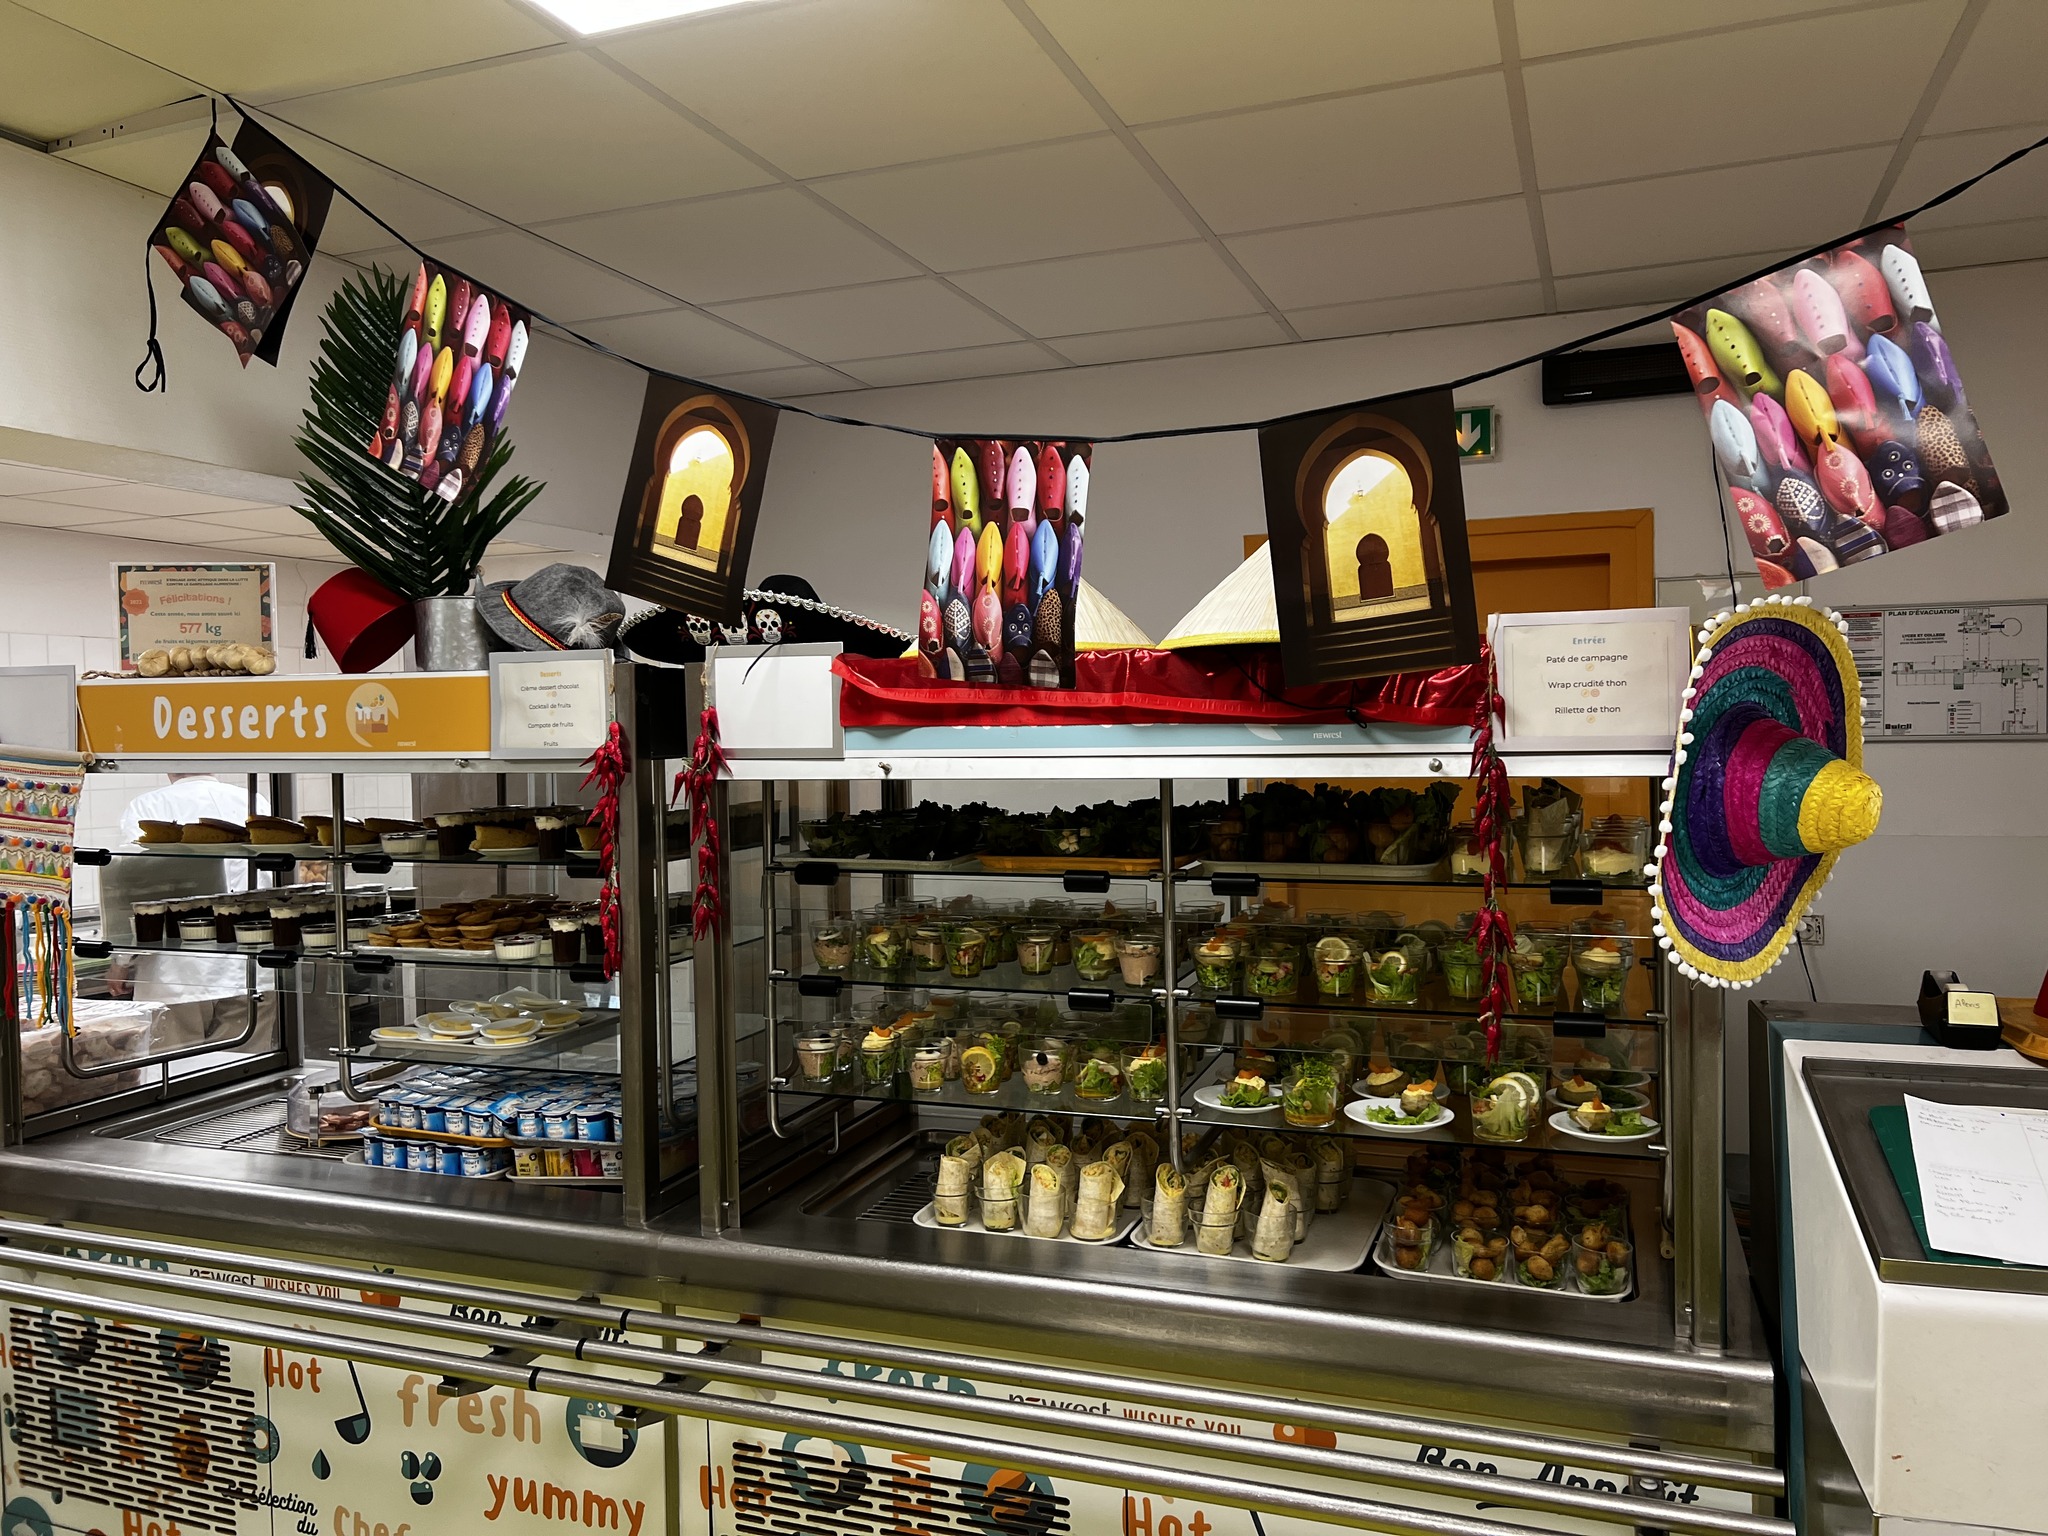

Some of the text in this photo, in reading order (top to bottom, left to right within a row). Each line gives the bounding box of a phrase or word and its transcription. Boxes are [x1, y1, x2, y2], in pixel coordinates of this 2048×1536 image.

[160, 593, 225, 605] Félicitations
[1908, 608, 1960, 616] D'ÉVACUATION
[180, 622, 222, 636] 577 kg
[1572, 636, 1606, 645] Entrées
[1546, 655, 1566, 663] Paté
[1580, 654, 1628, 663] campagne
[1547, 679, 1627, 689] Wrap crudité thon
[1554, 706, 1585, 714] Rillette
[1599, 705, 1621, 713] thon
[153, 696, 328, 740] Desserts
[1312, 731, 1343, 739] newrest
[264, 1347, 322, 1393] Hot
[397, 1374, 541, 1444] fresh
[699, 1465, 773, 1517] Hot
[484, 1474, 646, 1536] yummy
[1122, 1496, 1212, 1536] Hot
[297, 1516, 318, 1536] du
